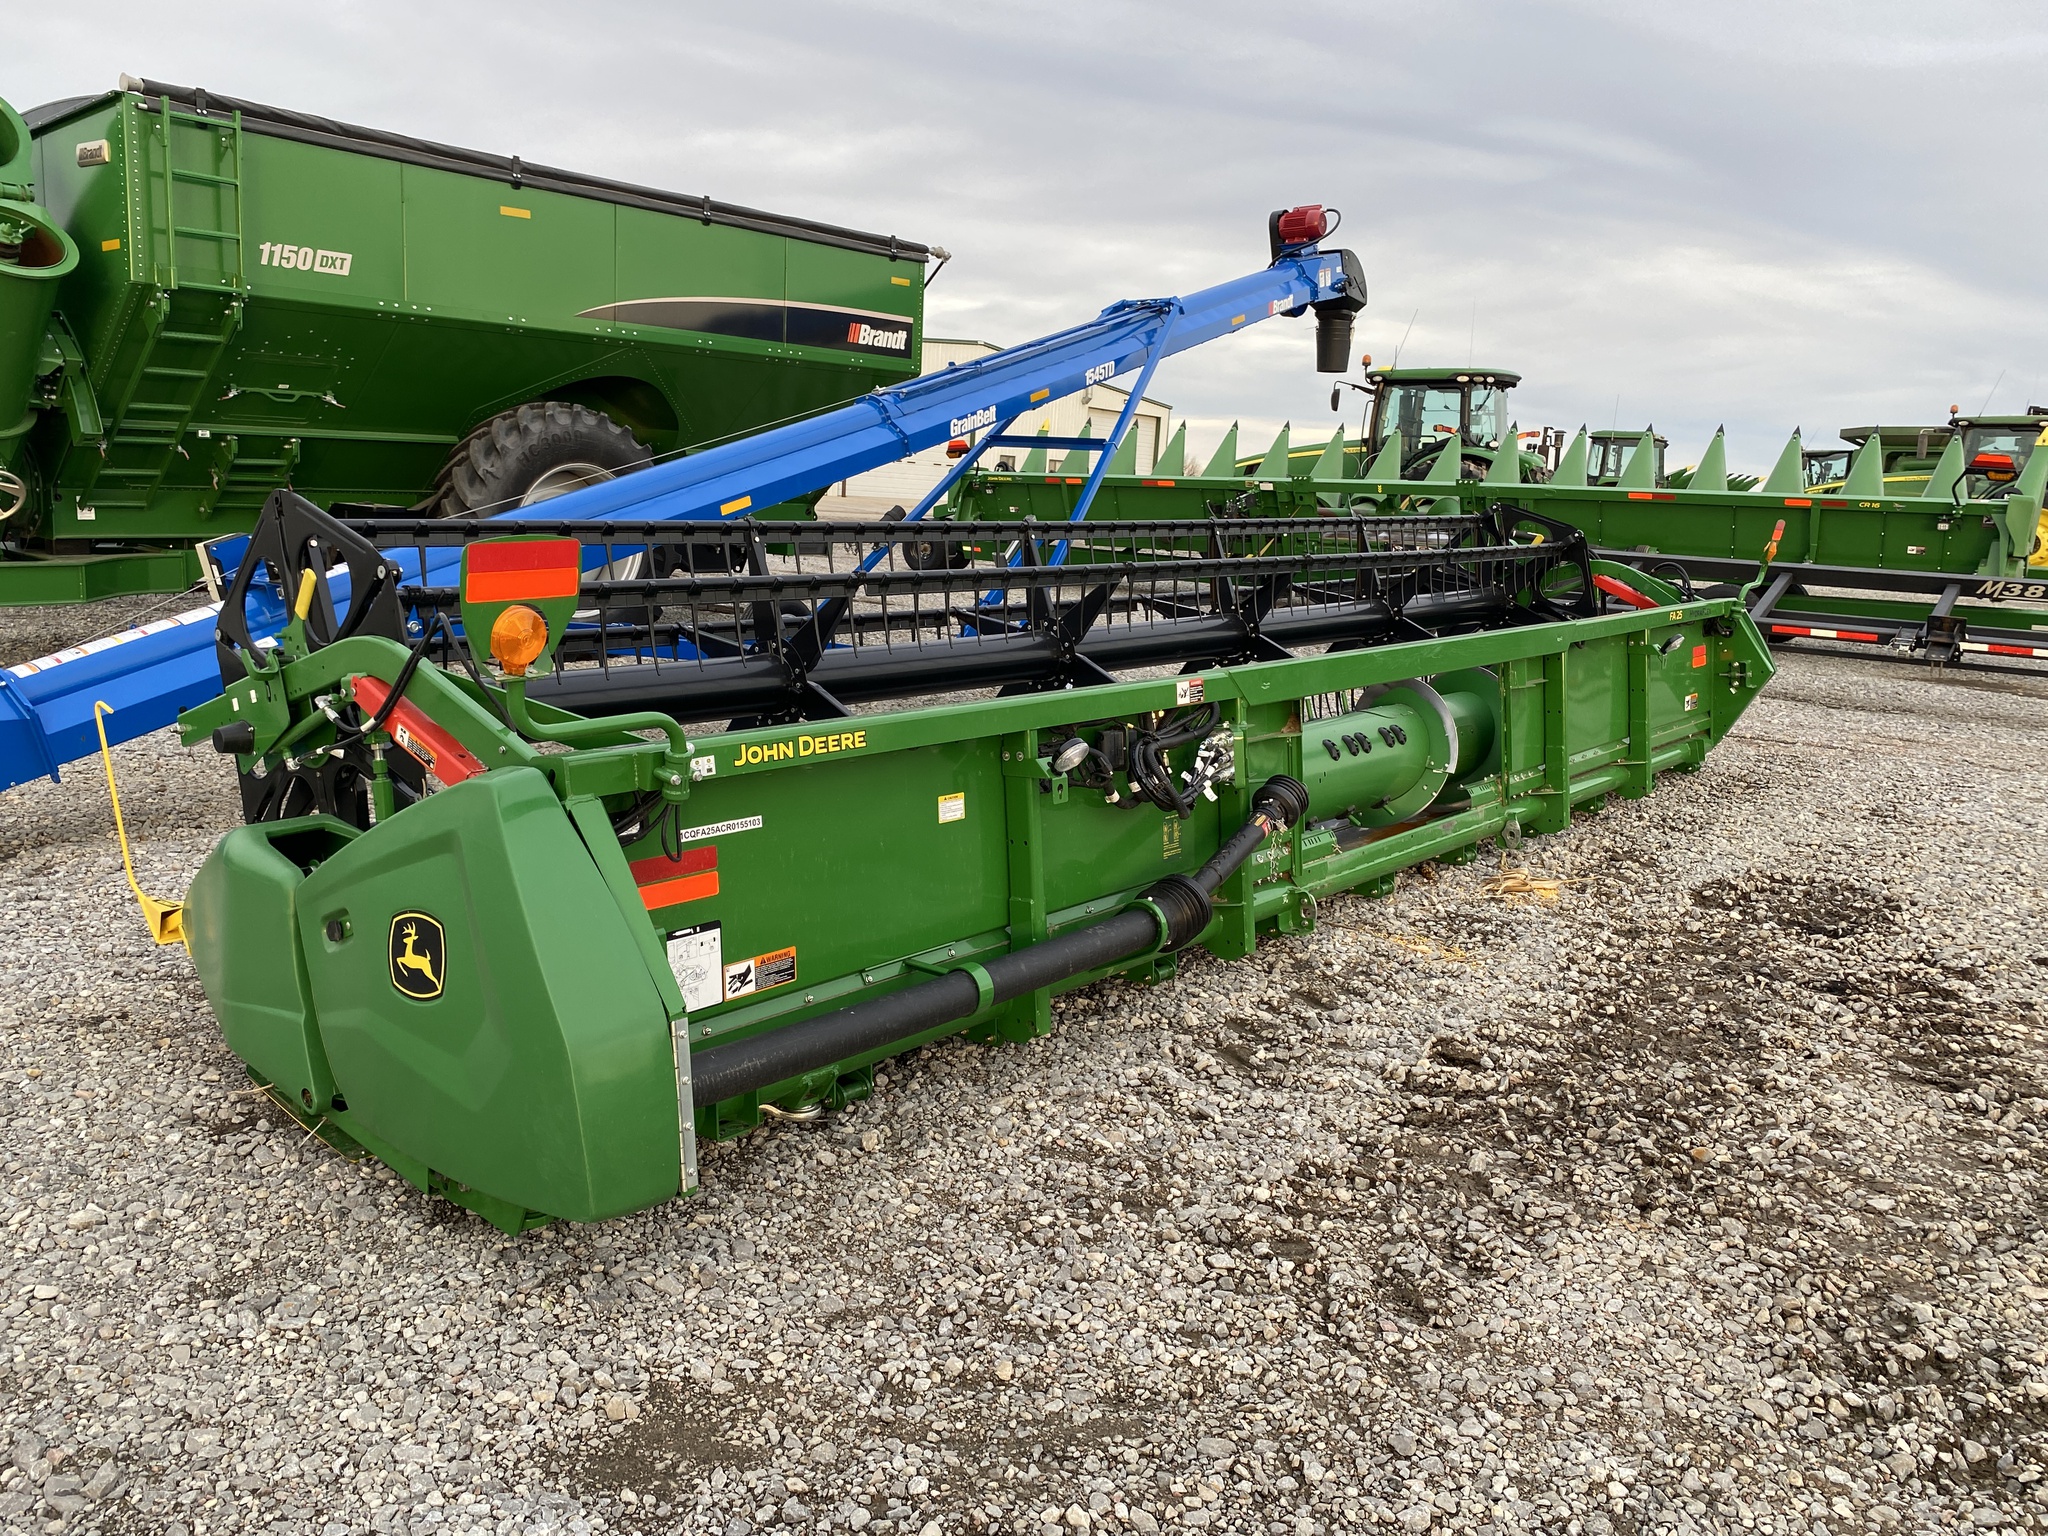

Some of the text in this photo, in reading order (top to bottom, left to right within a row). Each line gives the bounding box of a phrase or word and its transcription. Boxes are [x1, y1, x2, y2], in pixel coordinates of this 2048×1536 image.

[260, 242, 347, 271] 1150 DXT
[858, 323, 907, 350] Brandt
[1085, 360, 1115, 386] 1545TD
[950, 405, 997, 437] GrainBelt
[1976, 580, 2046, 598] M38
[734, 730, 867, 767] JOHN DEERE
[766, 950, 791, 963] WARNING
